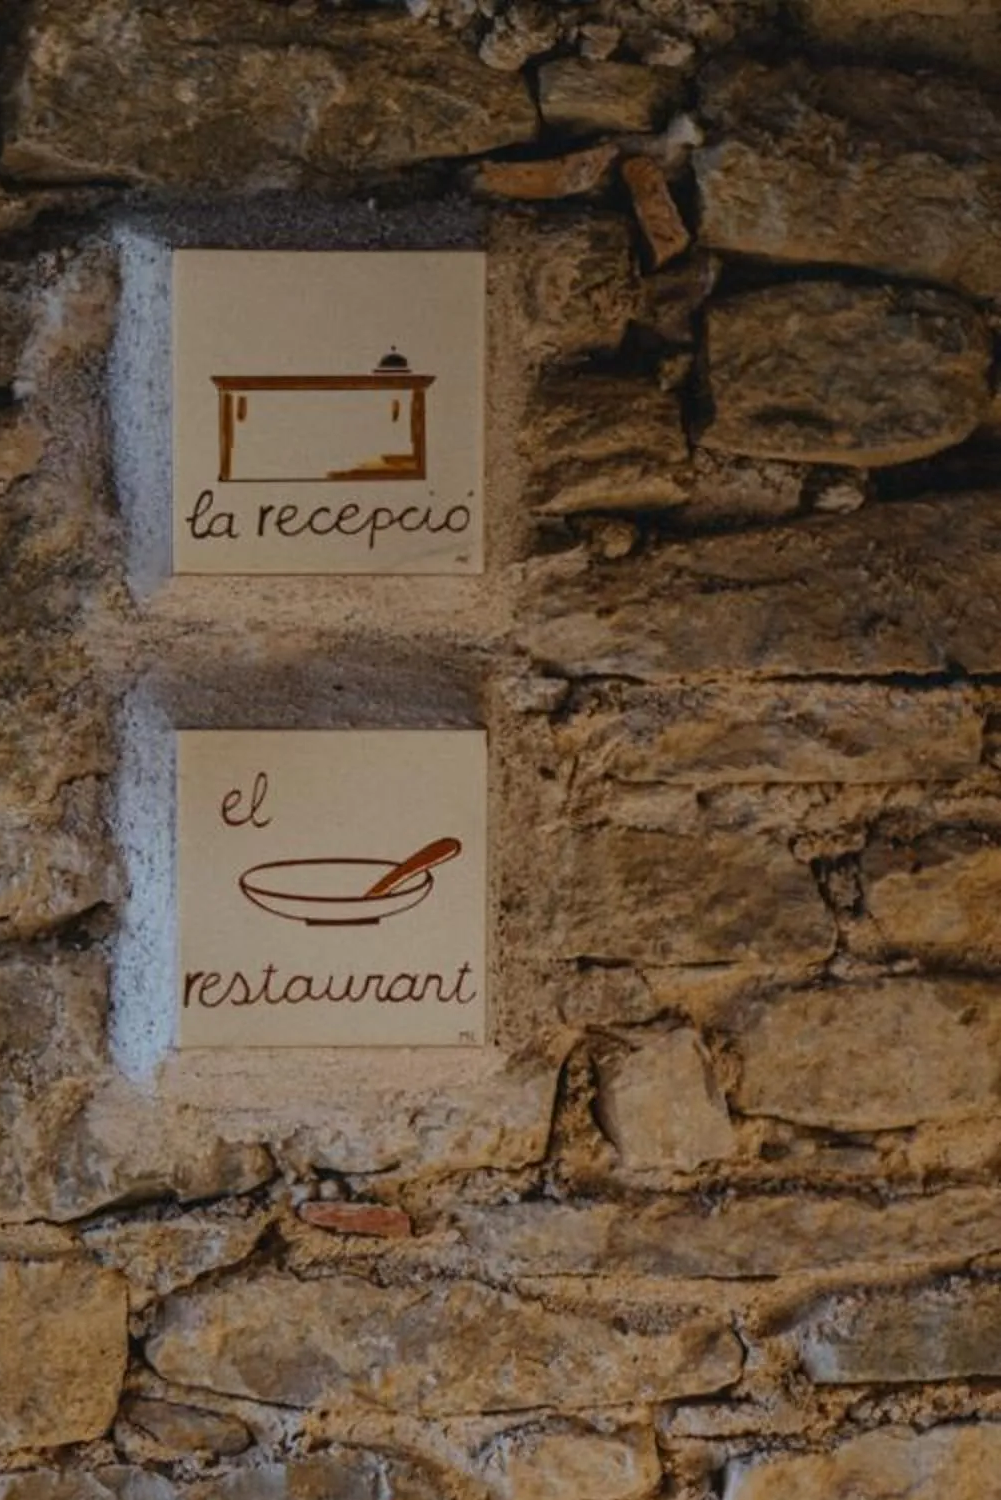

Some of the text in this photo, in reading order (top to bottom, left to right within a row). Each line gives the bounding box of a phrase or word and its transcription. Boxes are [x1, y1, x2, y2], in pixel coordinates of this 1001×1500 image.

[186, 490, 474, 549] la recepció
[221, 772, 272, 828] el
[184, 961, 476, 1008] restaurant
